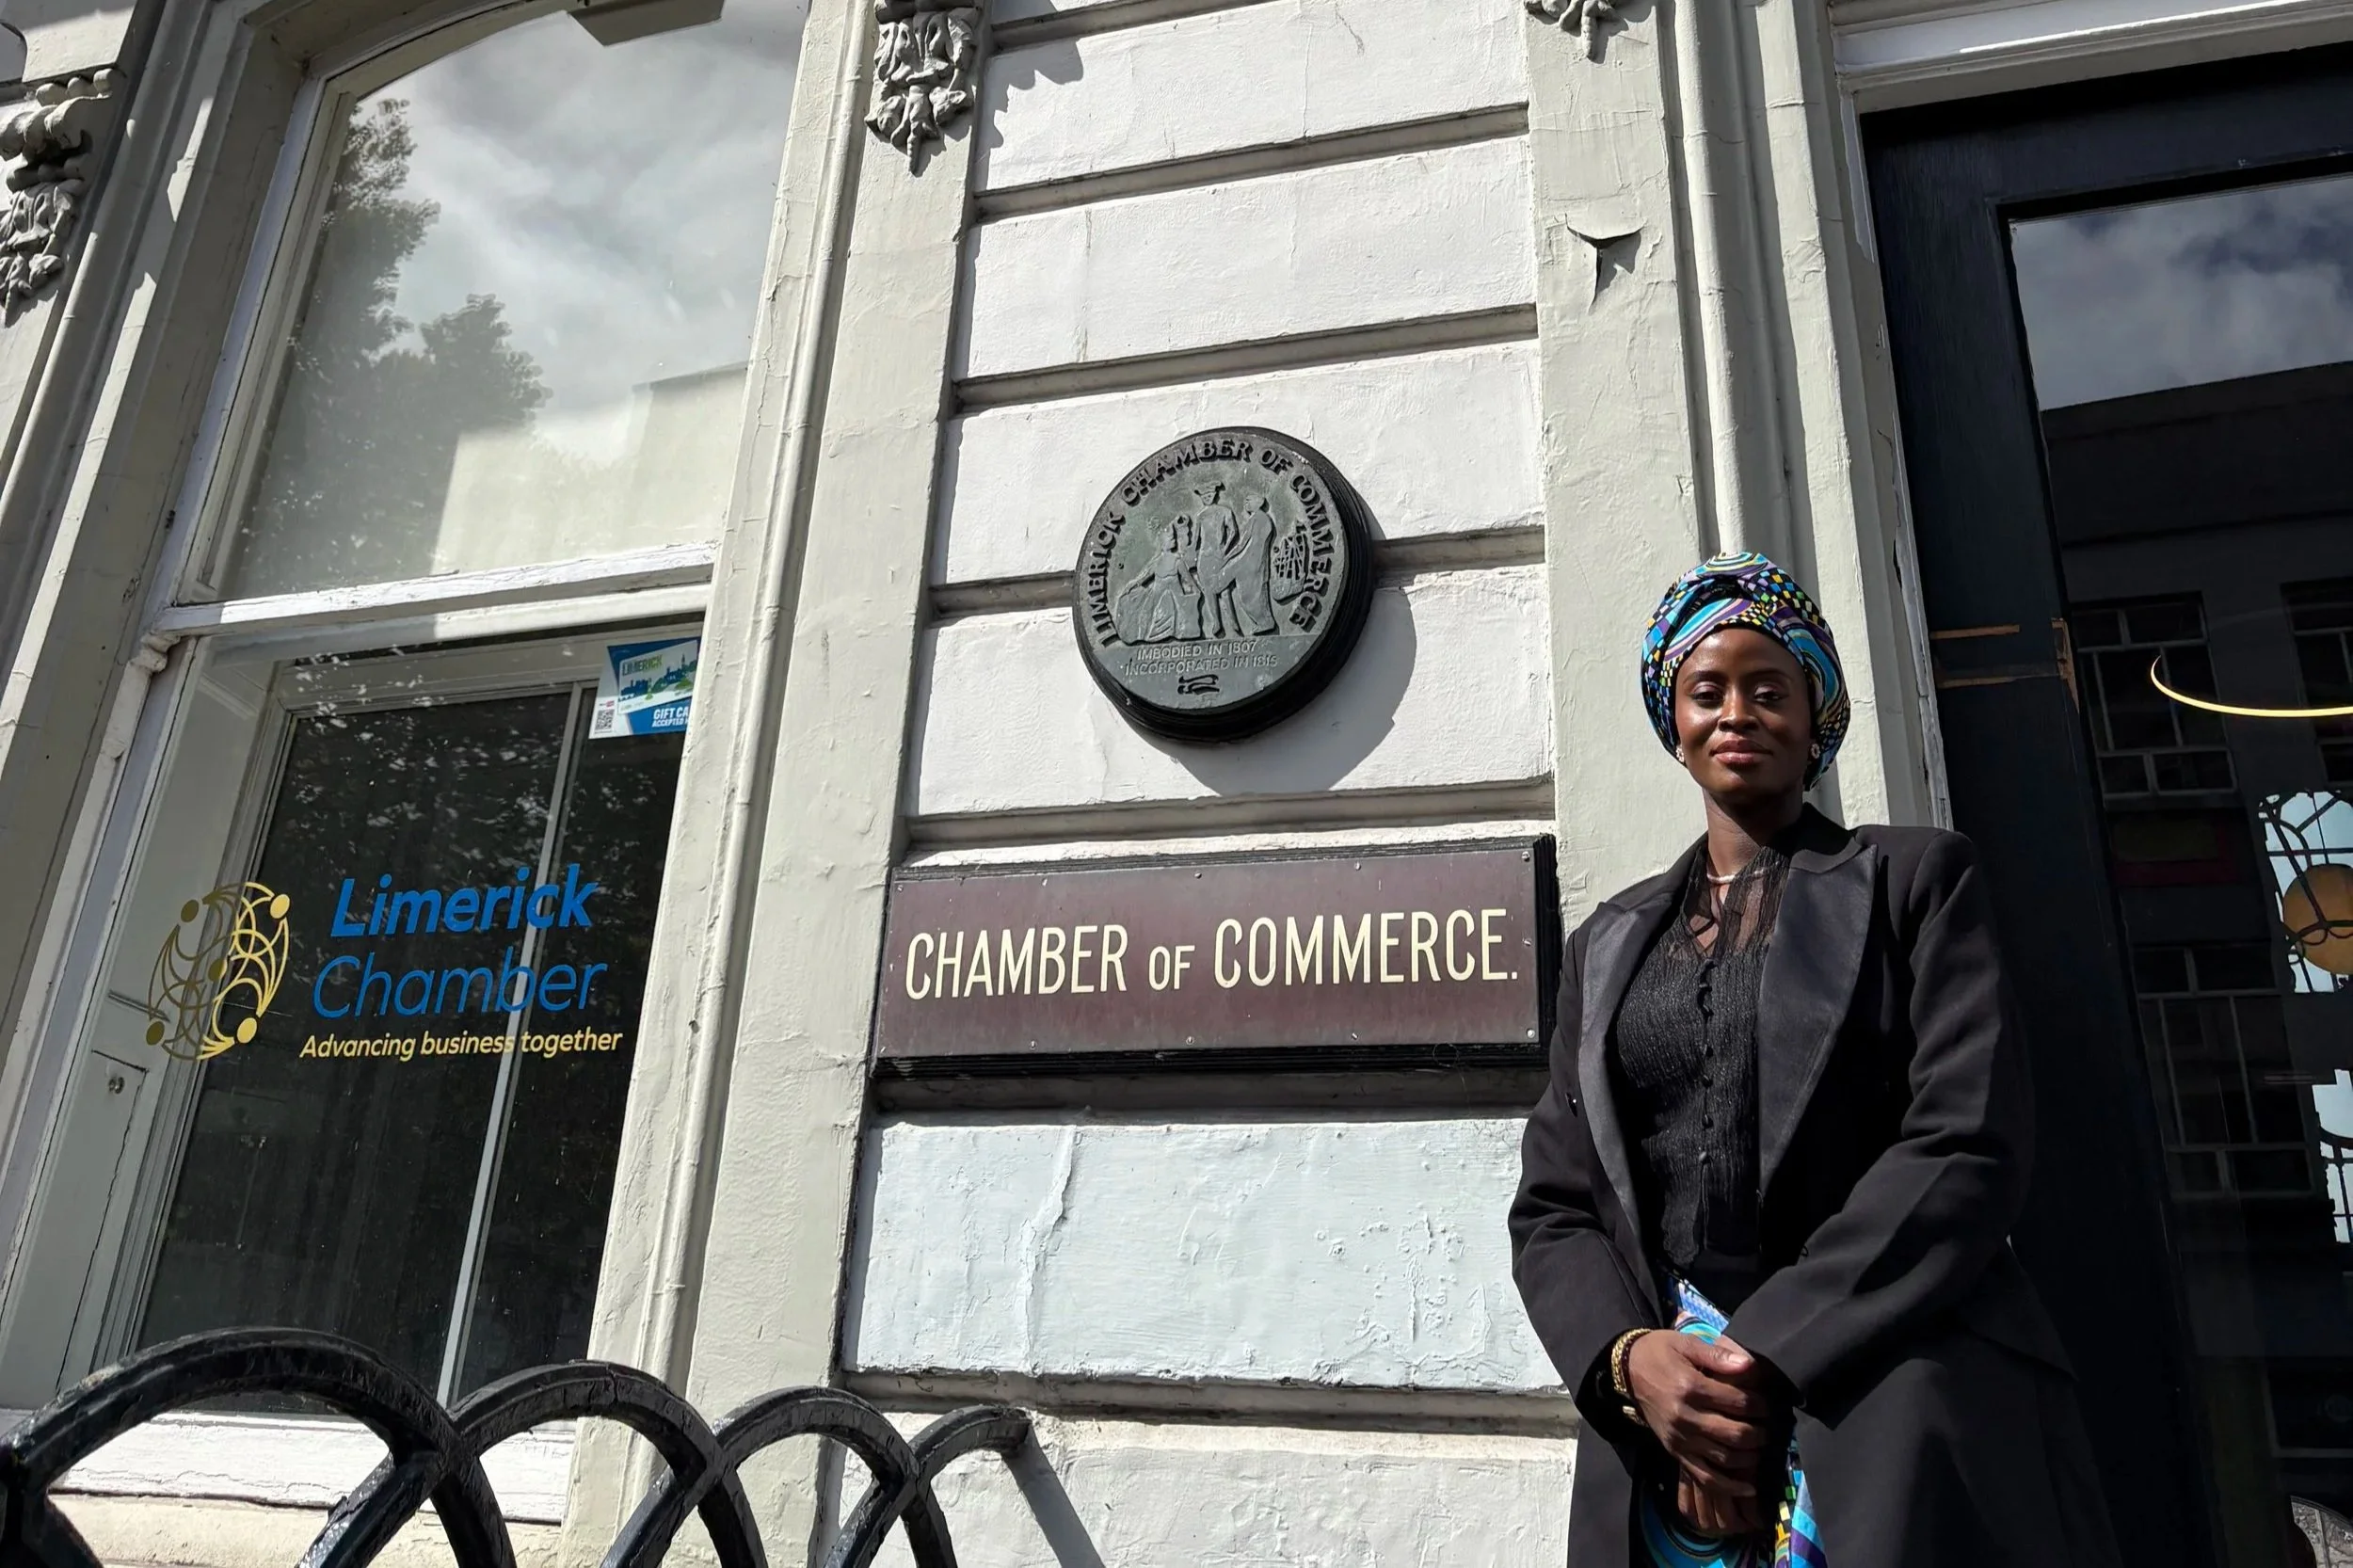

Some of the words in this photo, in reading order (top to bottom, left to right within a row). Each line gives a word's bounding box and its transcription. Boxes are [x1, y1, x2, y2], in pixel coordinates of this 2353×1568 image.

[1088, 511, 1126, 648] LIMERICK
[1121, 440, 1253, 506] CHAMBER
[1259, 449, 1294, 475] OF
[1289, 474, 1335, 633] COMMERCE
[1125, 657, 1228, 676] INCORPORATED
[1234, 656, 1249, 668] IN
[1137, 644, 1202, 660] IMBODIED
[1209, 642, 1224, 656] IN
[1228, 640, 1257, 656] 1807
[652, 718, 683, 728] ACCEPTED
[653, 707, 676, 720] GIFT
[677, 706, 689, 718] CA
[330, 863, 599, 937] Limerick
[905, 923, 1128, 1000] CHAMBER
[1148, 945, 1195, 991] OF
[1213, 908, 1518, 988] COMMERCE.
[314, 947, 608, 1018] Chamber
[299, 1032, 415, 1062] Advancing
[420, 1031, 513, 1055] business
[520, 1027, 623, 1059] together
